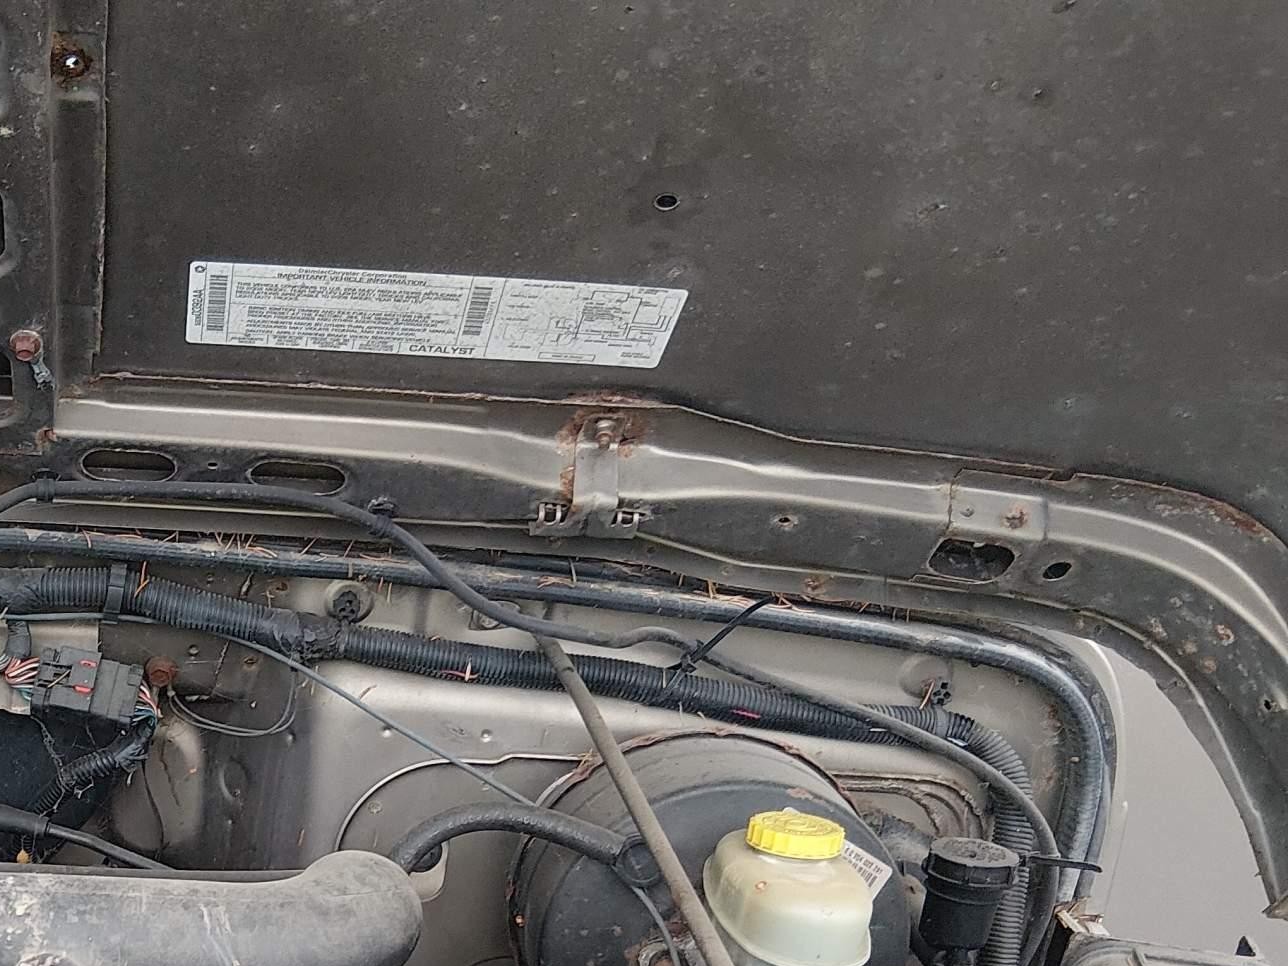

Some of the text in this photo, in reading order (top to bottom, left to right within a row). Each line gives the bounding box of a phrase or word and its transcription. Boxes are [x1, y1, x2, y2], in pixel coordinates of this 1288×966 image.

[277, 273, 428, 287] IMPORTANT VEHICLE INFORMATION
[408, 345, 475, 355] CATALYST
